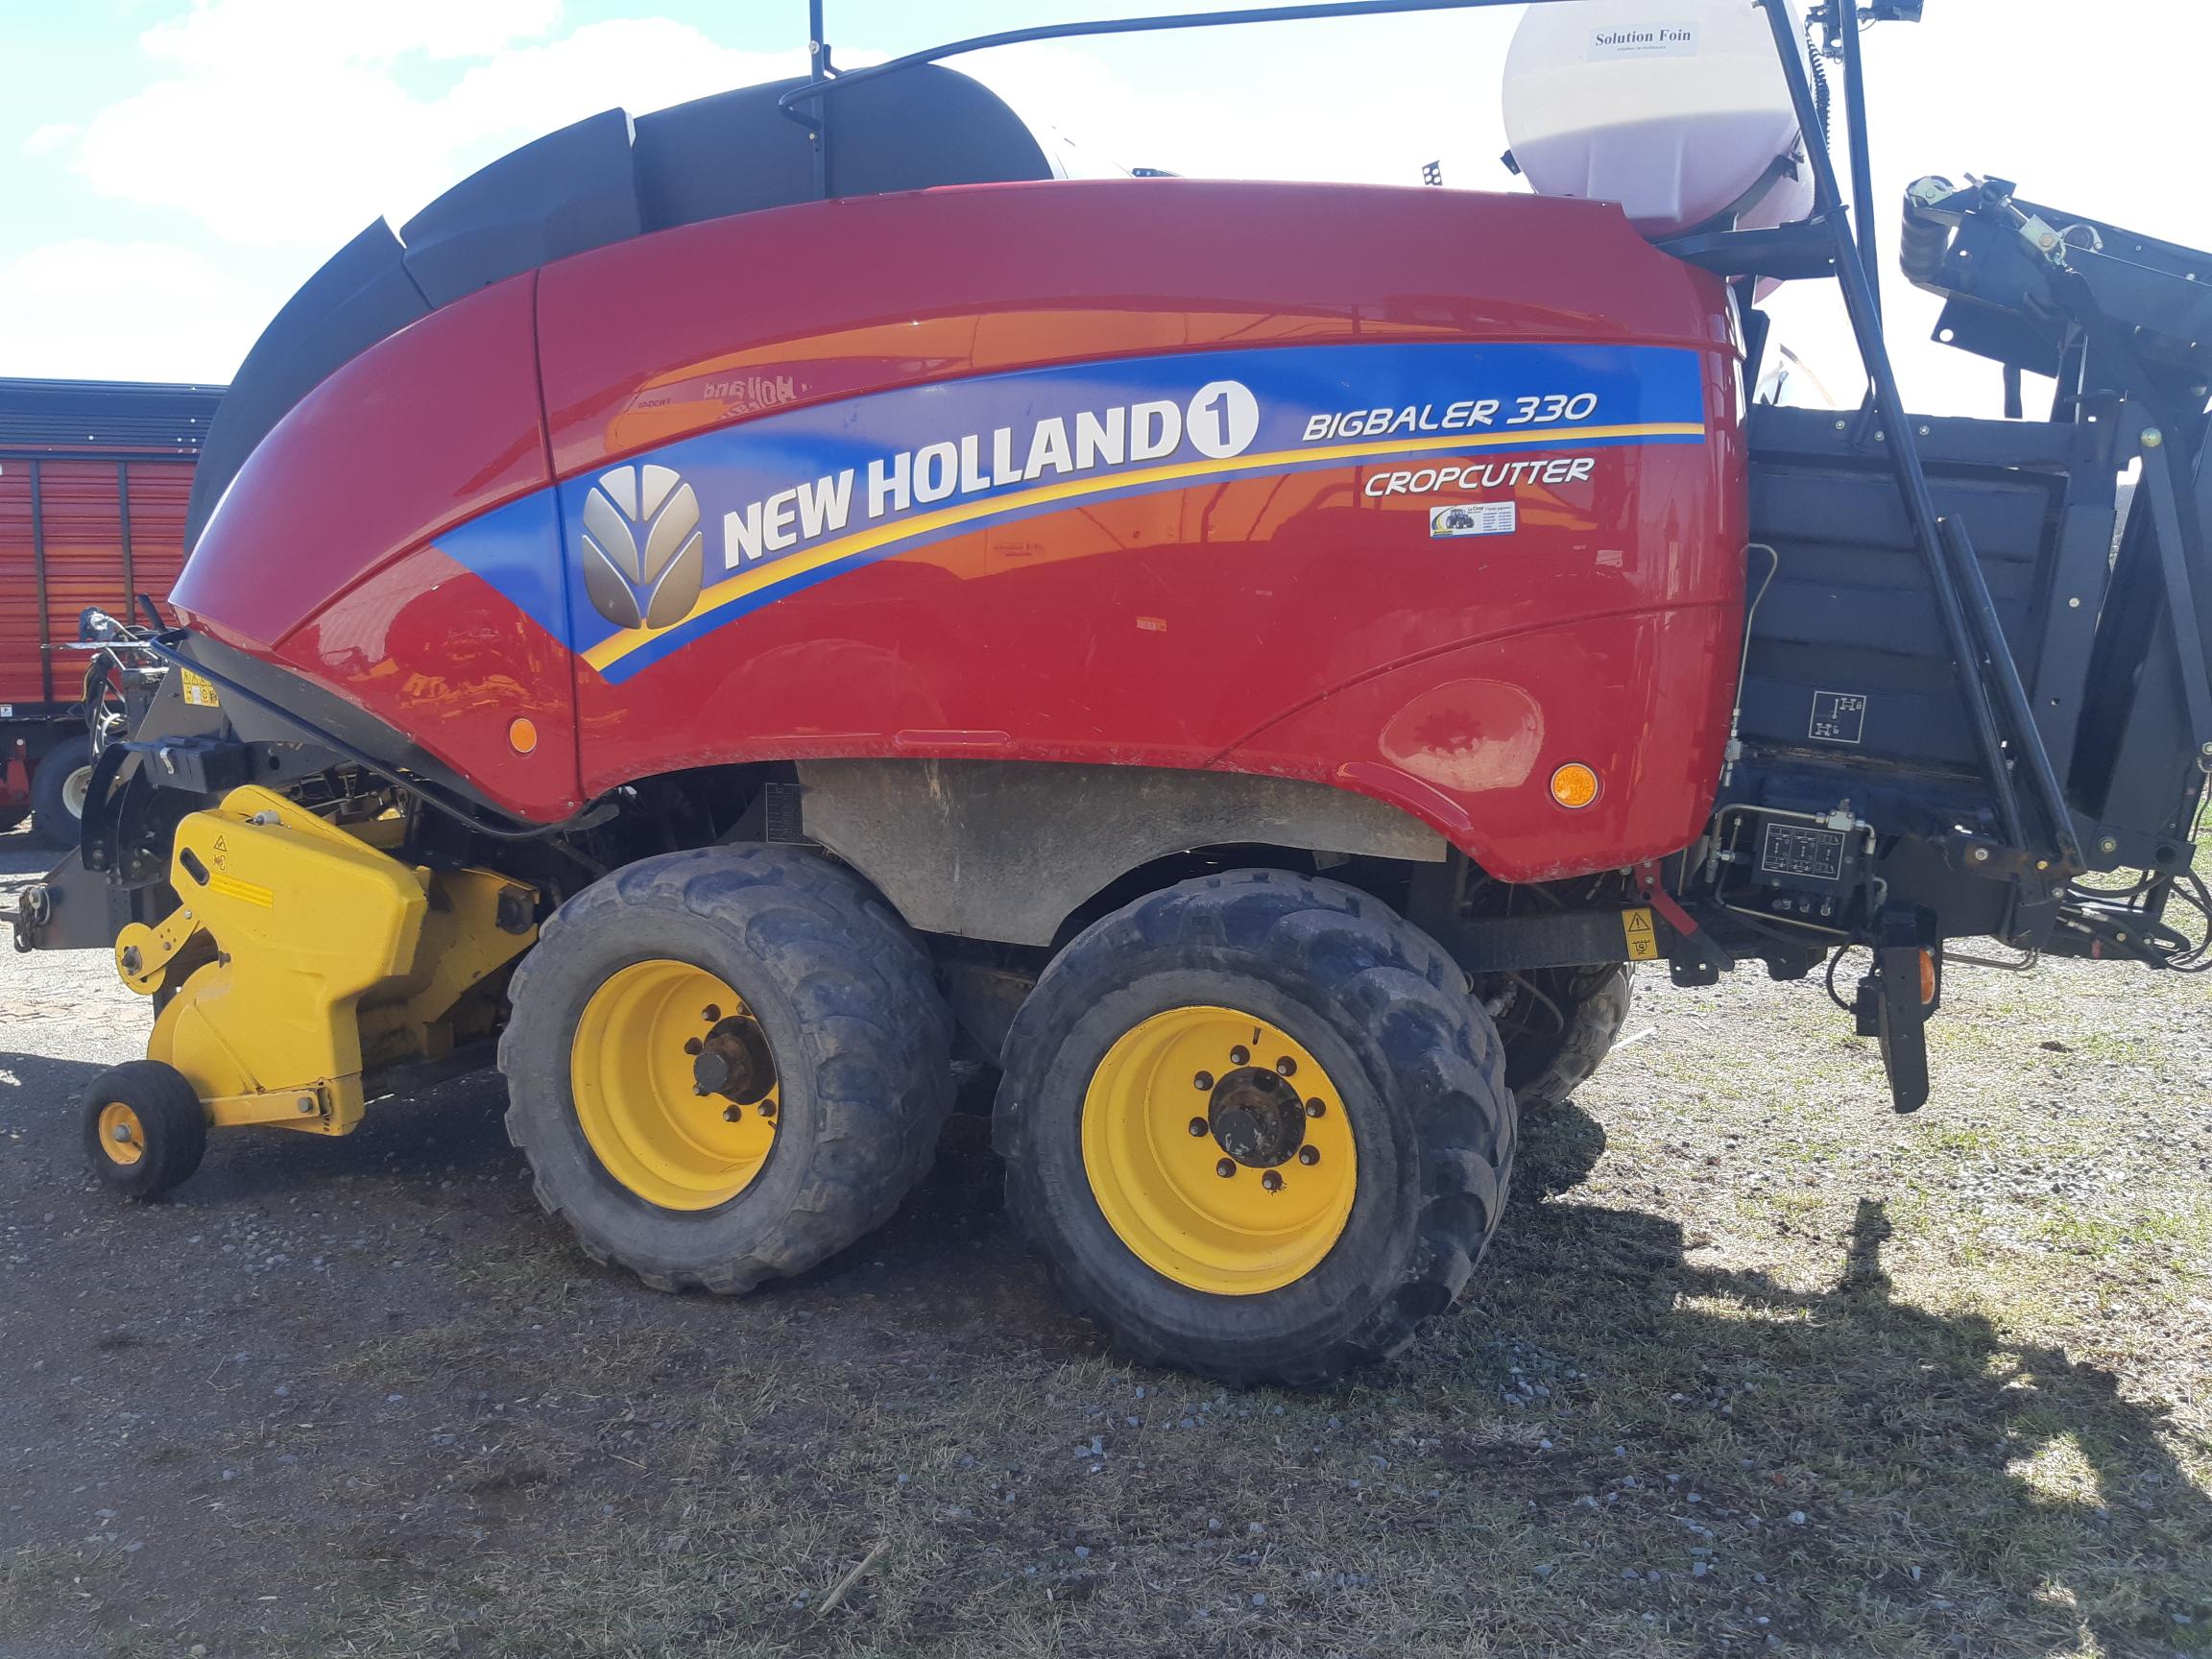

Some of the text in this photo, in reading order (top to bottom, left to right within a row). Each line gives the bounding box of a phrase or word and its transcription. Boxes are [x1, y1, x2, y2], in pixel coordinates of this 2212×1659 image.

[1595, 29, 1691, 46] Solution Foin
[1302, 393, 1598, 442] BIGBALER 330
[723, 468, 854, 569] NEW
[868, 399, 1182, 518] HOLLAND
[1364, 457, 1596, 497] CROPCUTTER
